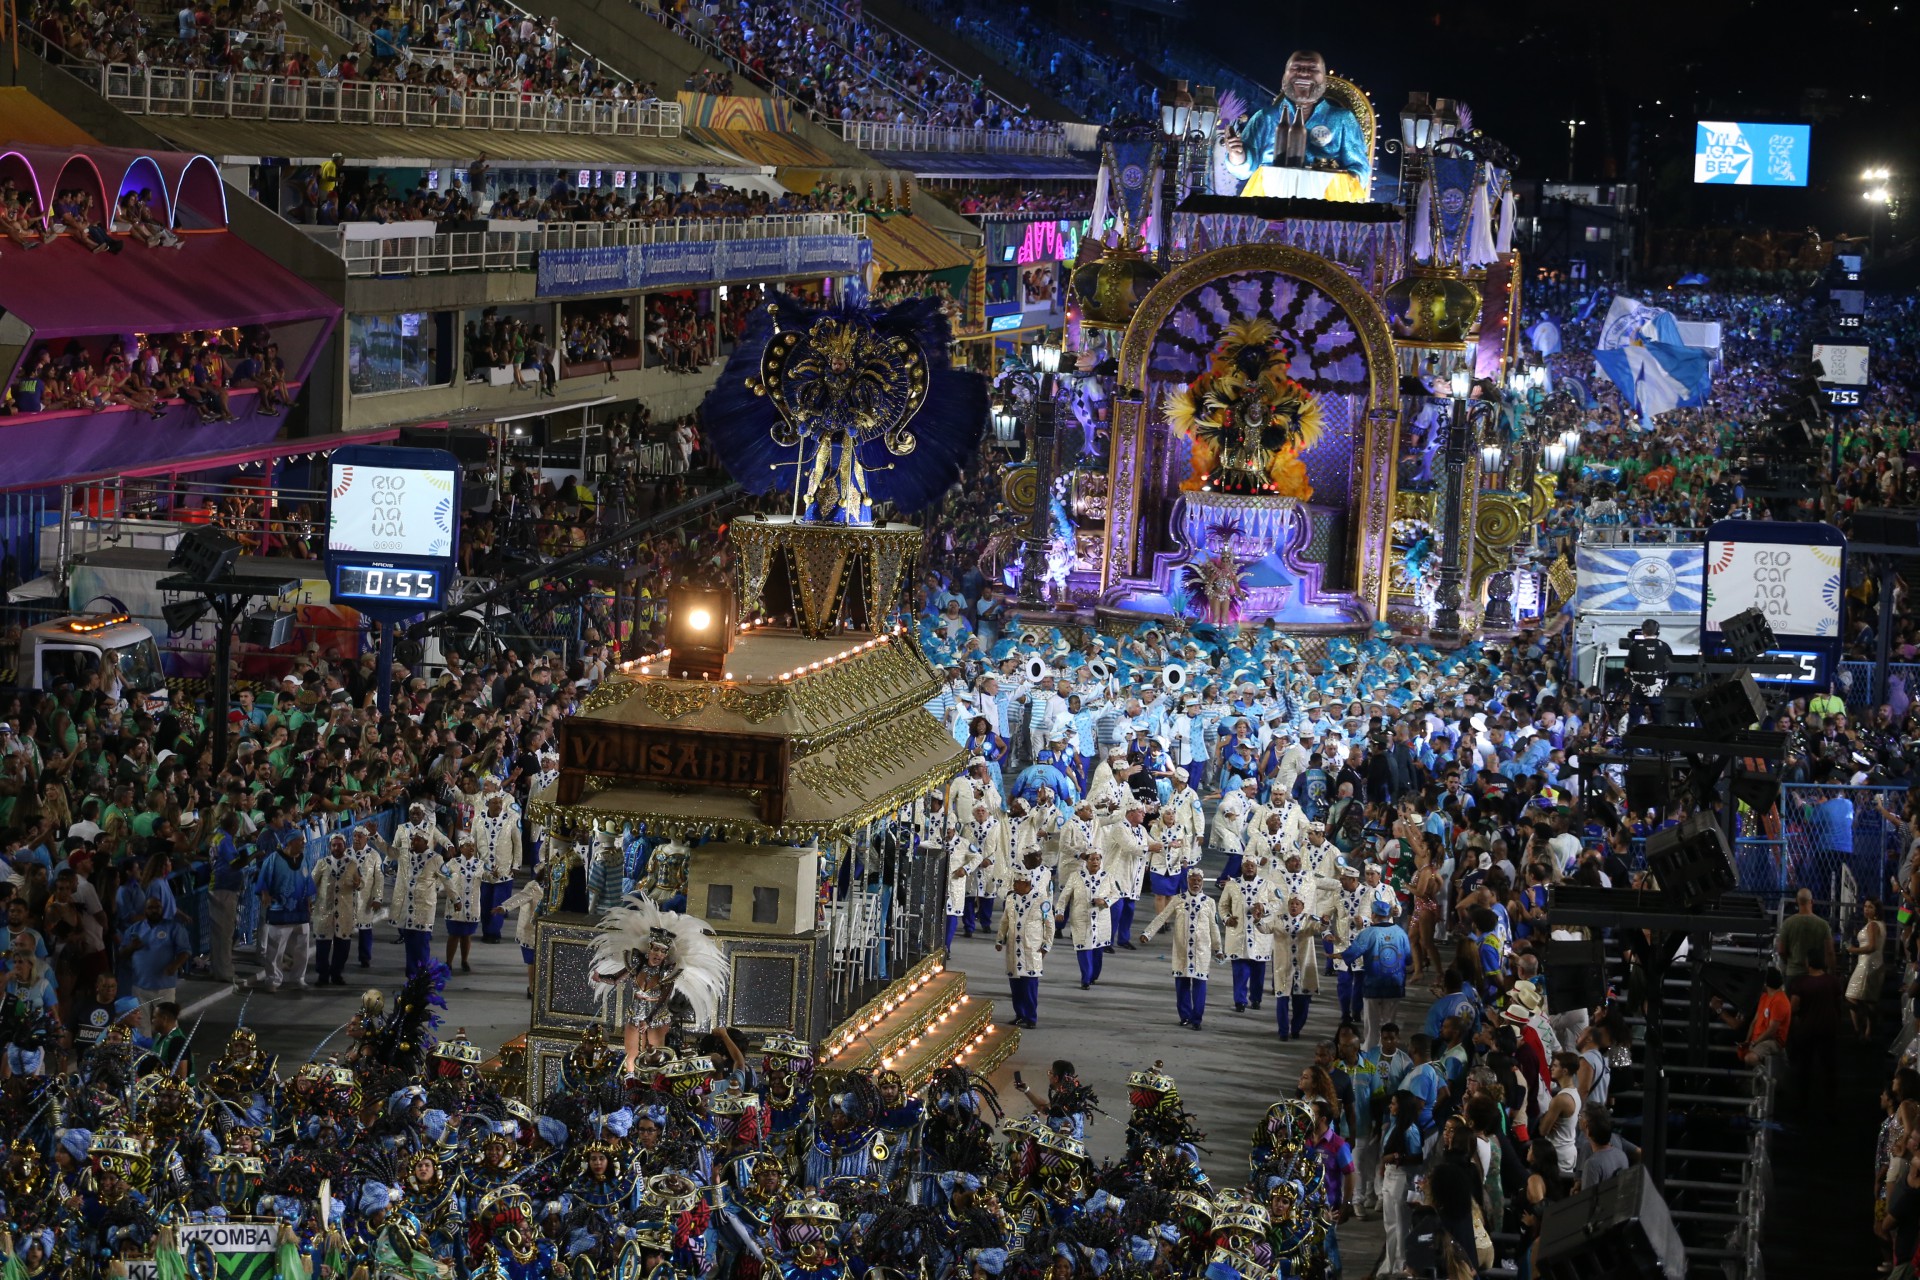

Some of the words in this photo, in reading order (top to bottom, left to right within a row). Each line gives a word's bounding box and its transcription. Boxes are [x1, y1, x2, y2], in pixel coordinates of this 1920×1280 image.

[1706, 161, 1738, 174] BEL
[365, 570, 433, 598] 0:55
[182, 1229, 272, 1247] KIZOMBA
